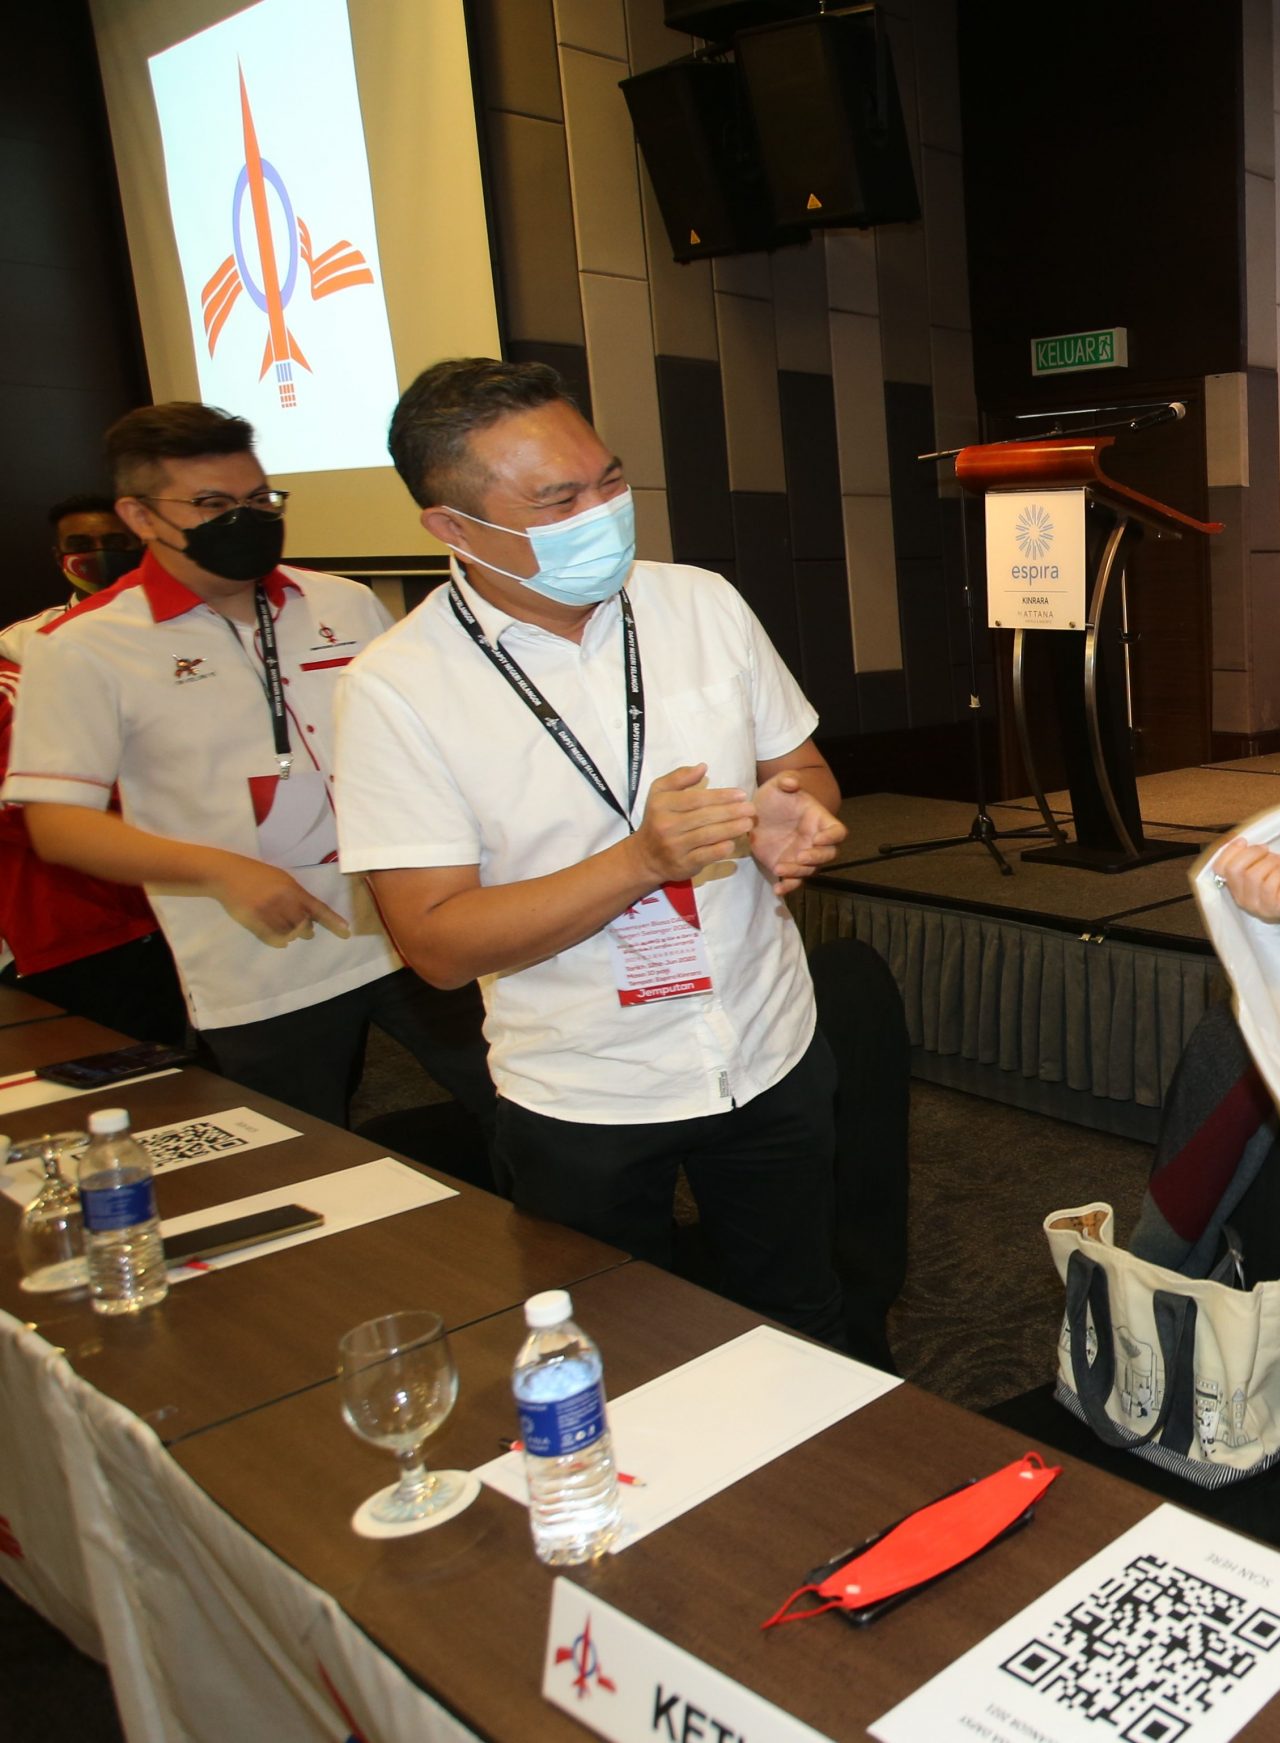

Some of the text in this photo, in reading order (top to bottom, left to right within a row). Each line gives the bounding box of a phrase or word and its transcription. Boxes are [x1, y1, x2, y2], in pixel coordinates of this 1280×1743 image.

[1037, 337, 1096, 367] KELUAR
[1011, 565, 1059, 586] espira
[635, 981, 696, 998] Jemputan
[1204, 1552, 1274, 1588] SCAN HERE
[652, 1683, 746, 1743] KET
